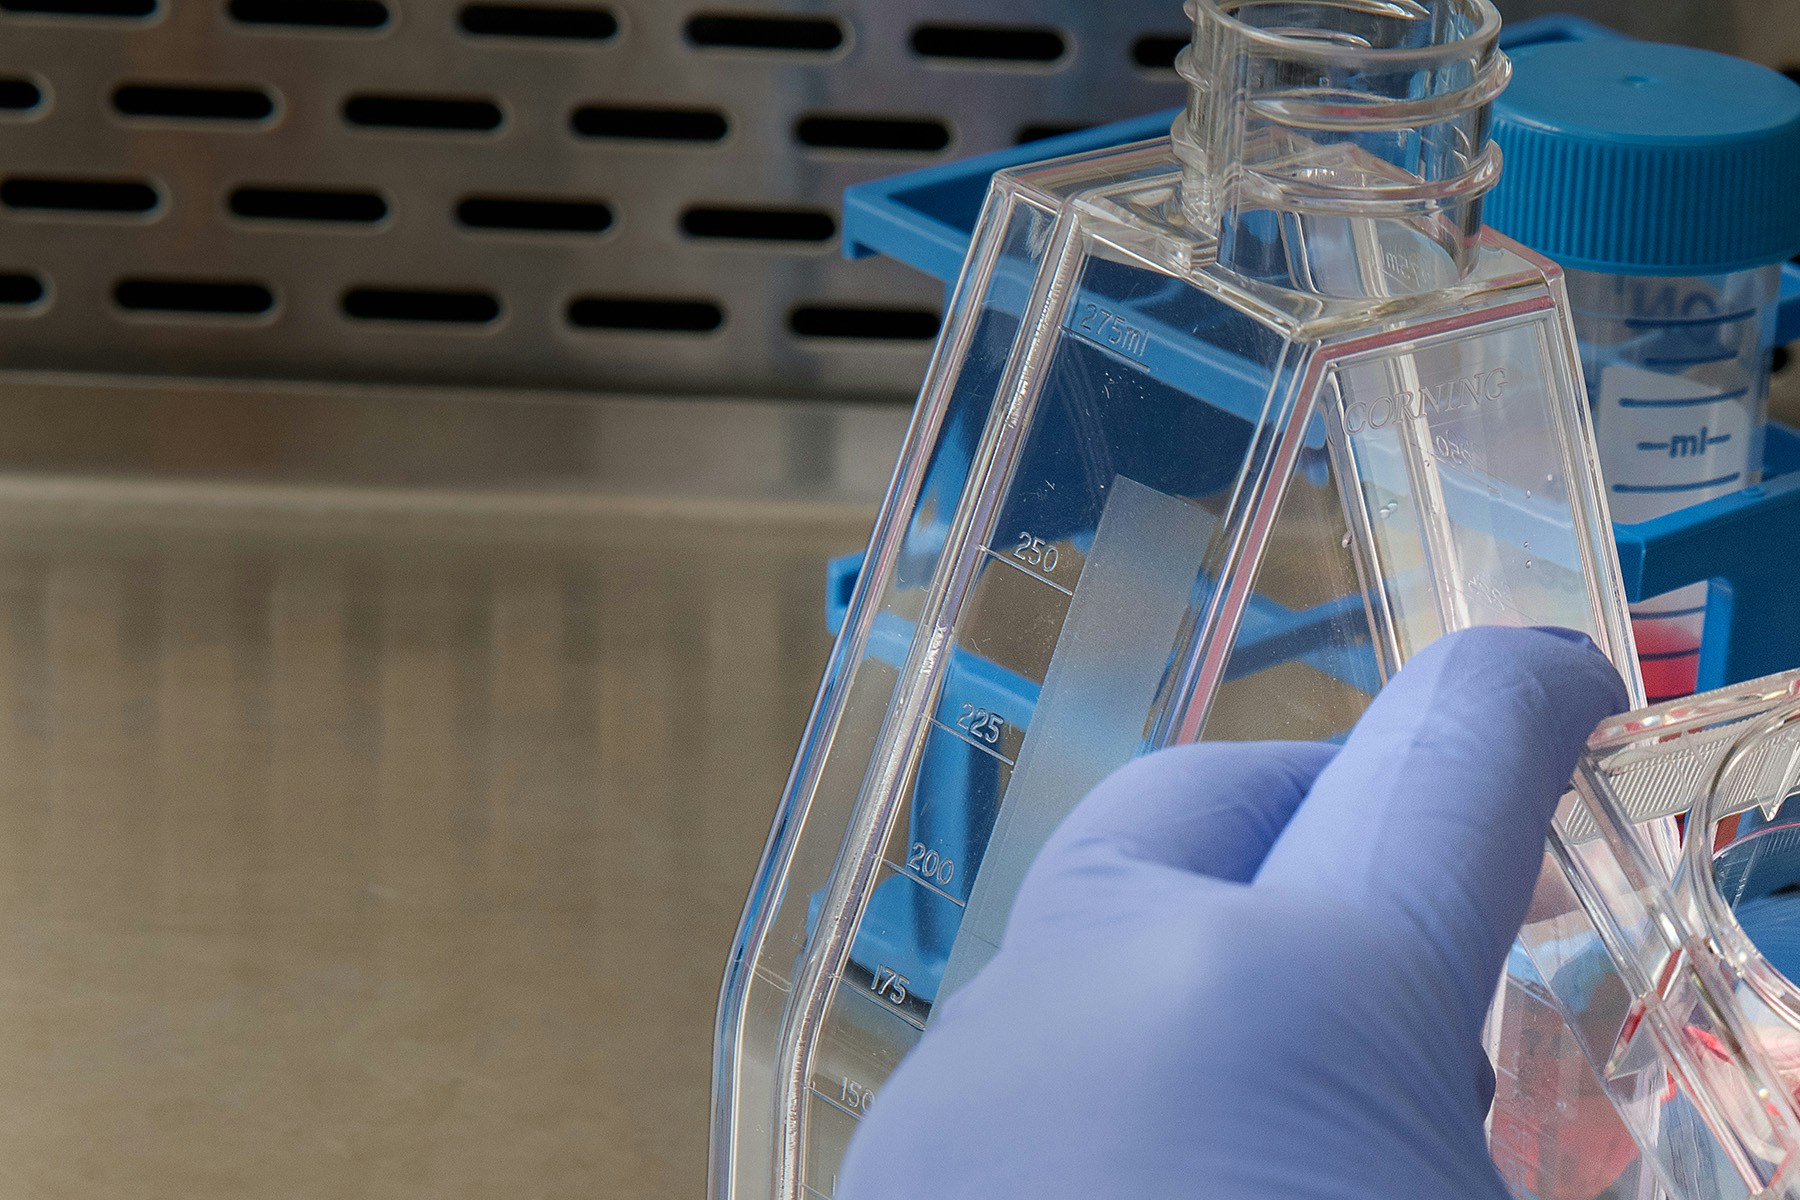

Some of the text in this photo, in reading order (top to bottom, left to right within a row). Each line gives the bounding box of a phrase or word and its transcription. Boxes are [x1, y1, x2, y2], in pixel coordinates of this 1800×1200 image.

[1078, 303, 1149, 358] 275ml
[1343, 367, 1508, 436] CORNING
[1015, 531, 1059, 575] 250
[957, 702, 1004, 744] 225
[907, 842, 954, 888] 200
[870, 961, 910, 1006] 175
